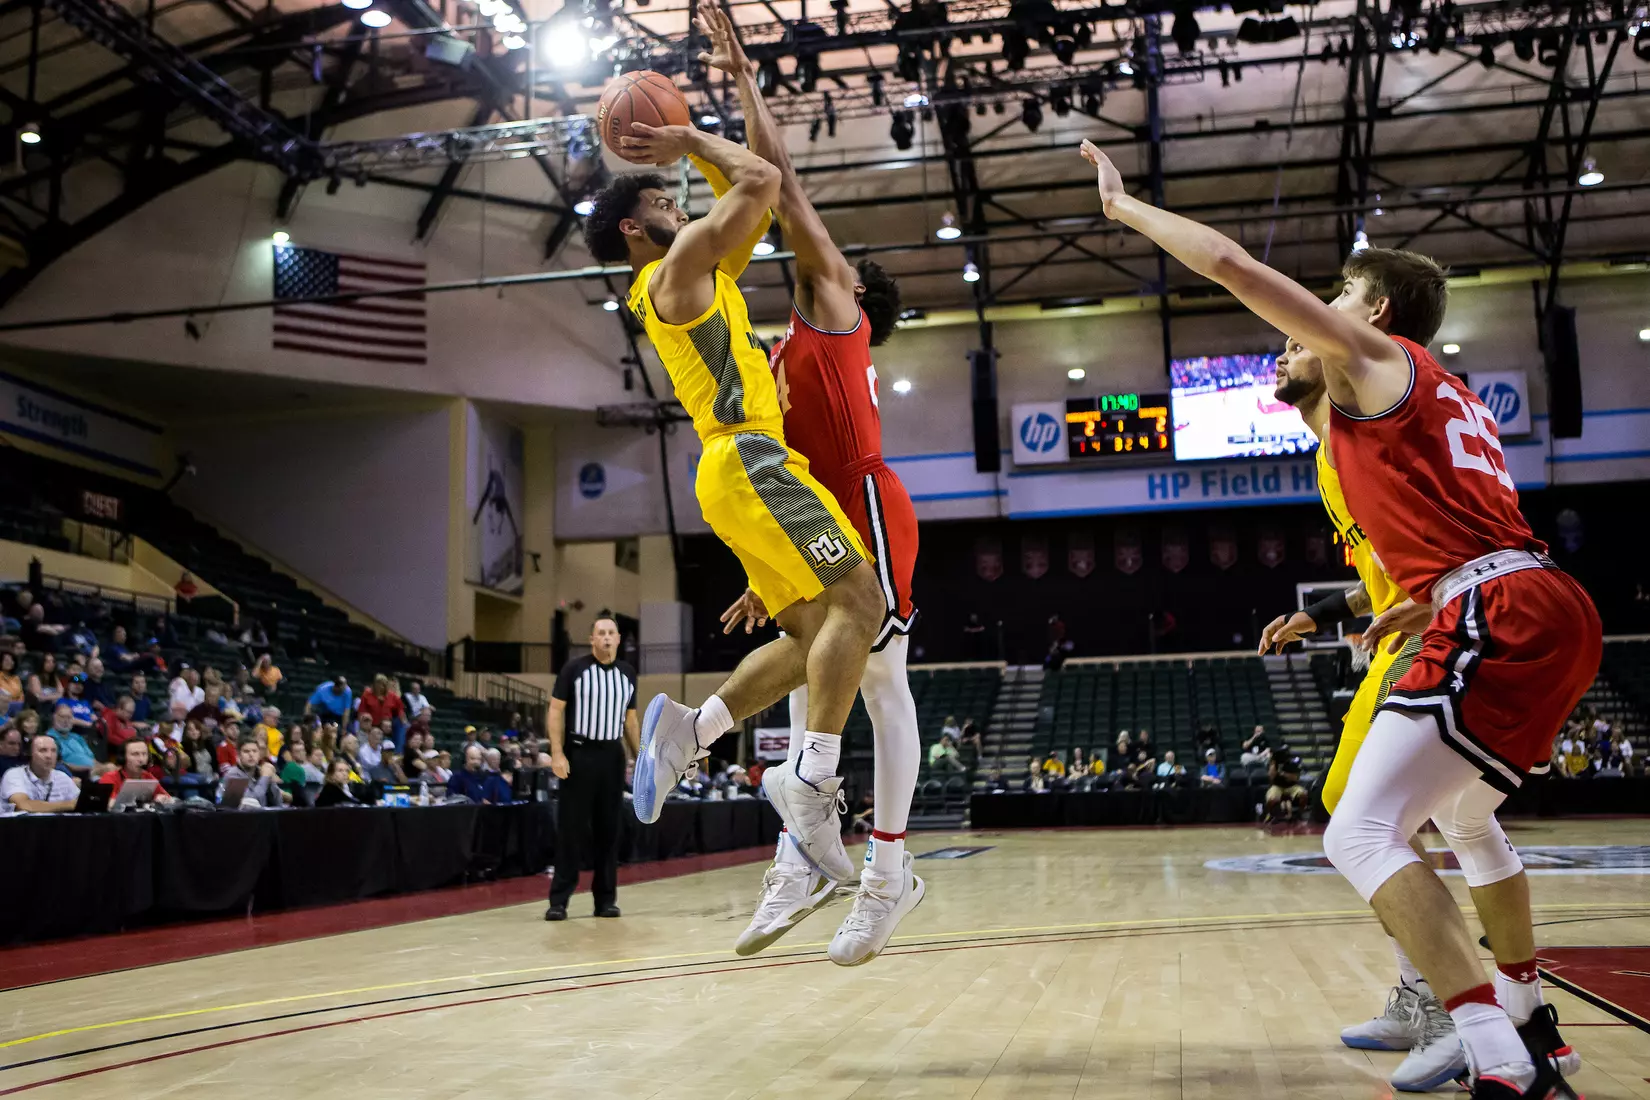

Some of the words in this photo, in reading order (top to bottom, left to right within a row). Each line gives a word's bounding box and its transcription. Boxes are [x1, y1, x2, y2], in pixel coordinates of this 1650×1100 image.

[16, 393, 89, 439] Strength
[1021, 412, 1061, 454] hp
[1148, 471, 1191, 500] HP
[1201, 464, 1281, 497] Field
[803, 529, 851, 568] MU
